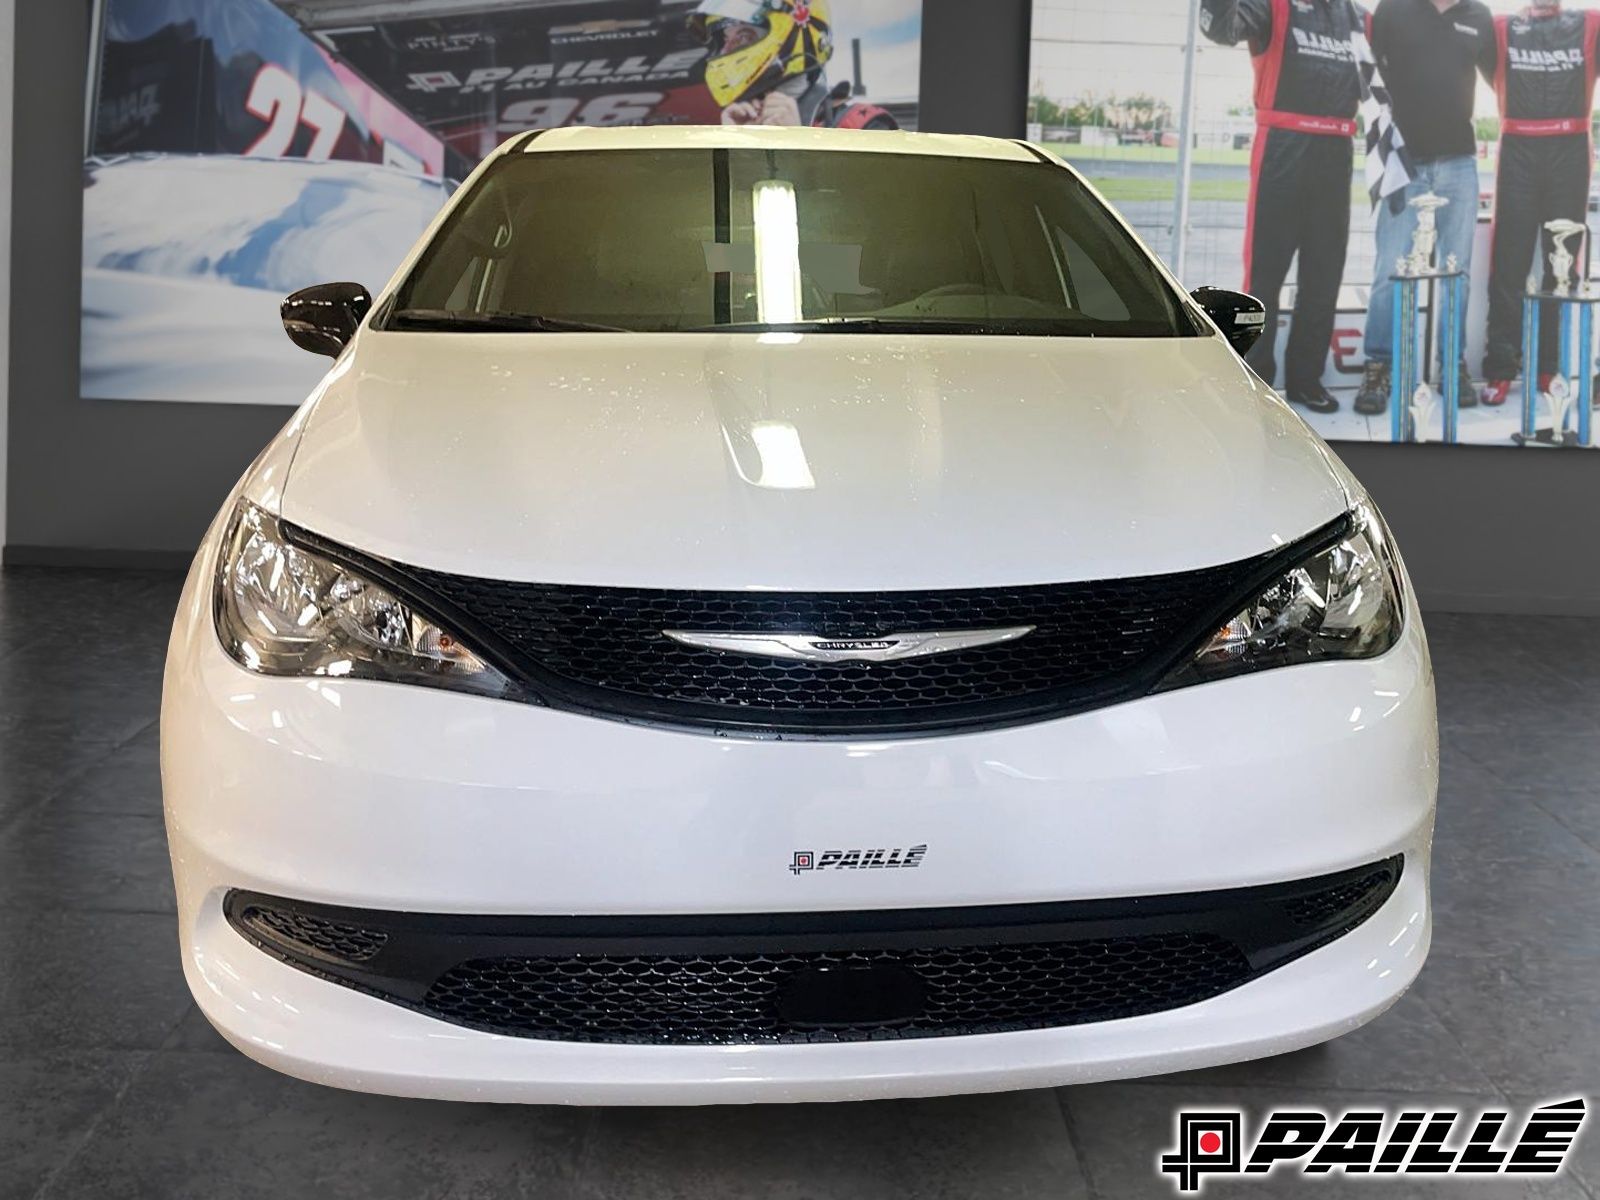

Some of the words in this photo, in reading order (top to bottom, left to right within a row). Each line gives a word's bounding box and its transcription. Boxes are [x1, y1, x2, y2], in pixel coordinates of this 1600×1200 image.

[550, 30, 658, 44] CHEVROLET
[503, 80, 546, 91] AU
[557, 70, 689, 86] CANADA
[245, 62, 345, 160] 27
[498, 92, 664, 132] 96
[816, 641, 889, 649] CHRYSLER
